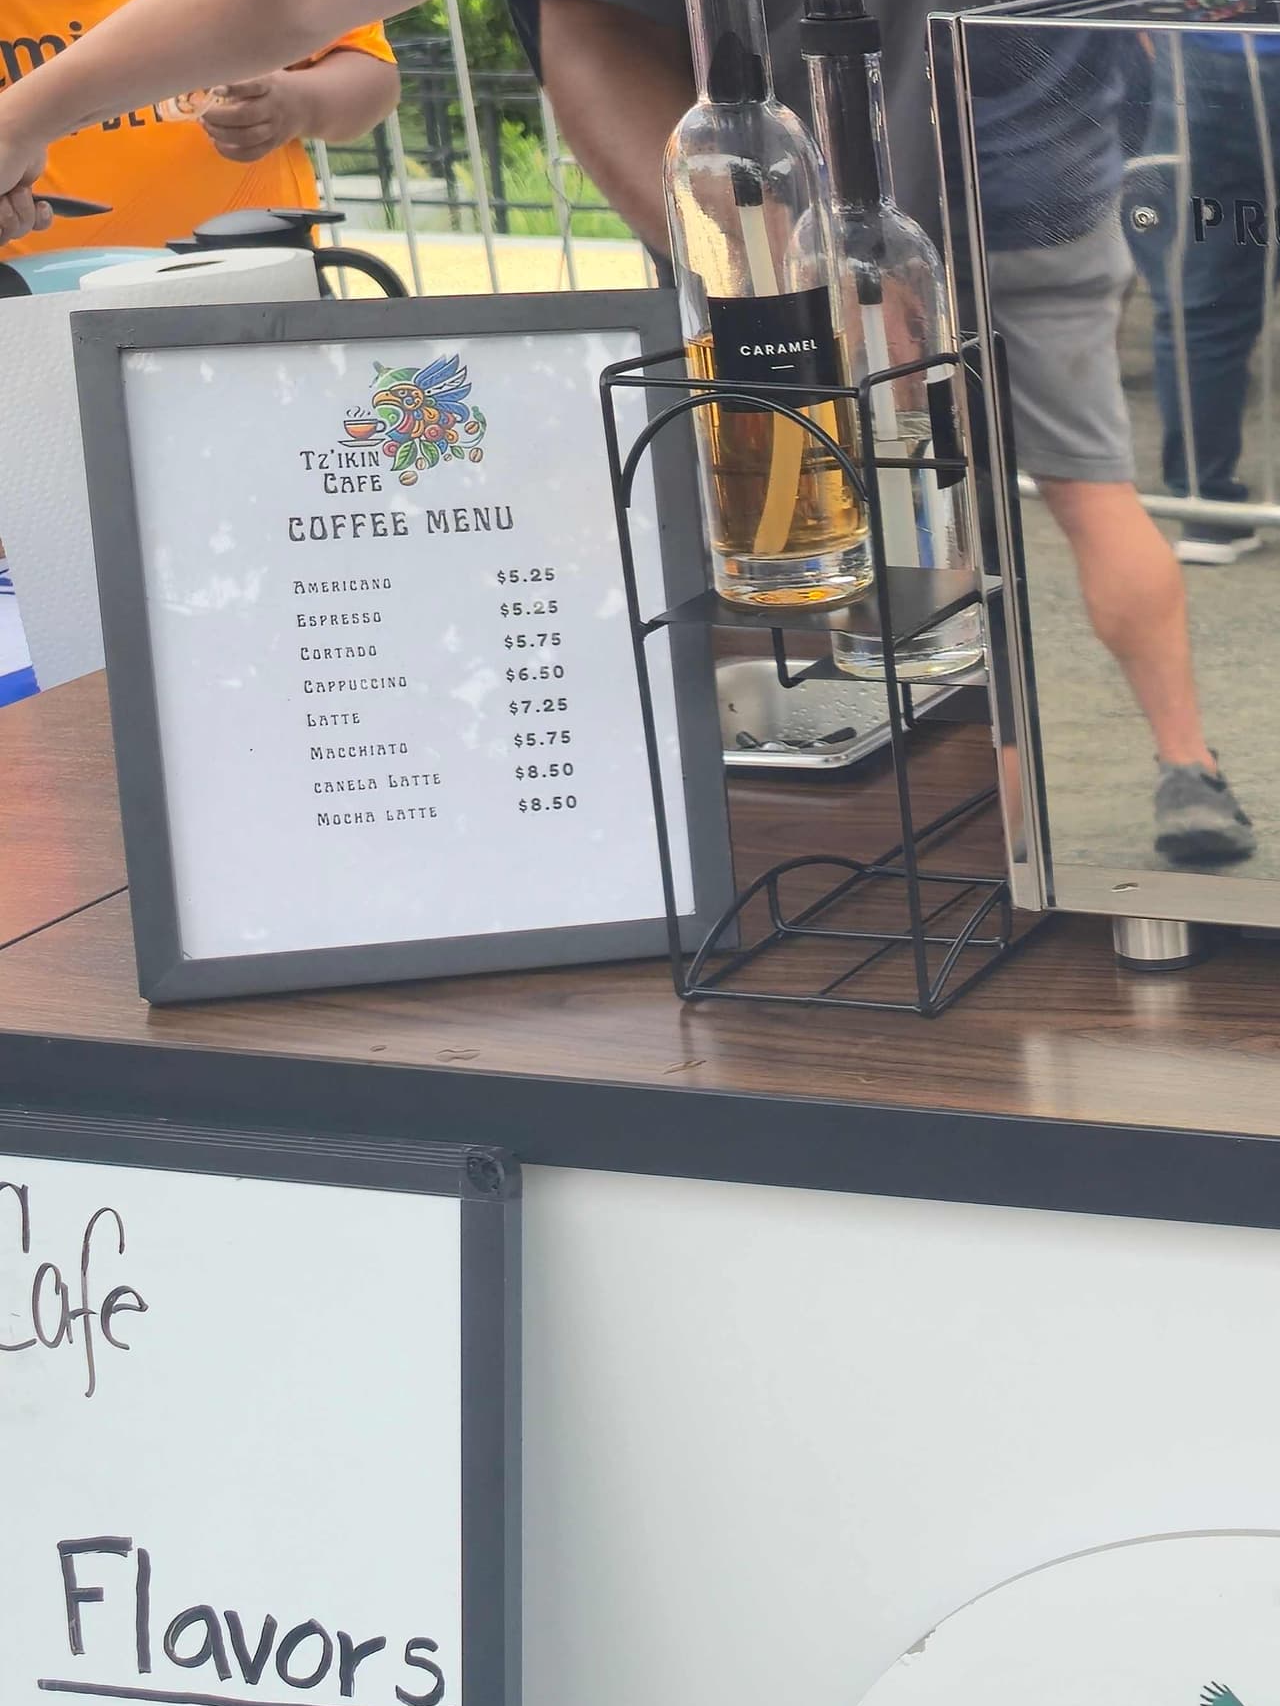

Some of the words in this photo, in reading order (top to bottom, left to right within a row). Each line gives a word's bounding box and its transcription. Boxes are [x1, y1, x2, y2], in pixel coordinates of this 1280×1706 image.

[740, 338, 818, 357] CARAMEL
[288, 512, 409, 542] COFFEE
[426, 505, 514, 534] MENU
[293, 578, 392, 594] AMERICANO
[497, 567, 556, 585] $5.25
[296, 612, 382, 627] ESPRESSO
[500, 600, 559, 618] $5.25
[300, 645, 377, 660] CORTADO
[504, 633, 562, 651] $5.75
[304, 677, 408, 693] CAPPUCCINO
[506, 665, 565, 683] $6.50
[306, 712, 361, 727] LATTE
[509, 698, 568, 716] $7.25
[310, 742, 409, 760] MACCHIATO
[514, 730, 572, 749] $5.75
[388, 773, 442, 788] LATTE
[515, 762, 574, 781] $8.50
[317, 811, 376, 826] MOCHA
[385, 806, 438, 821] LATTE
[518, 795, 577, 813] $8.50
